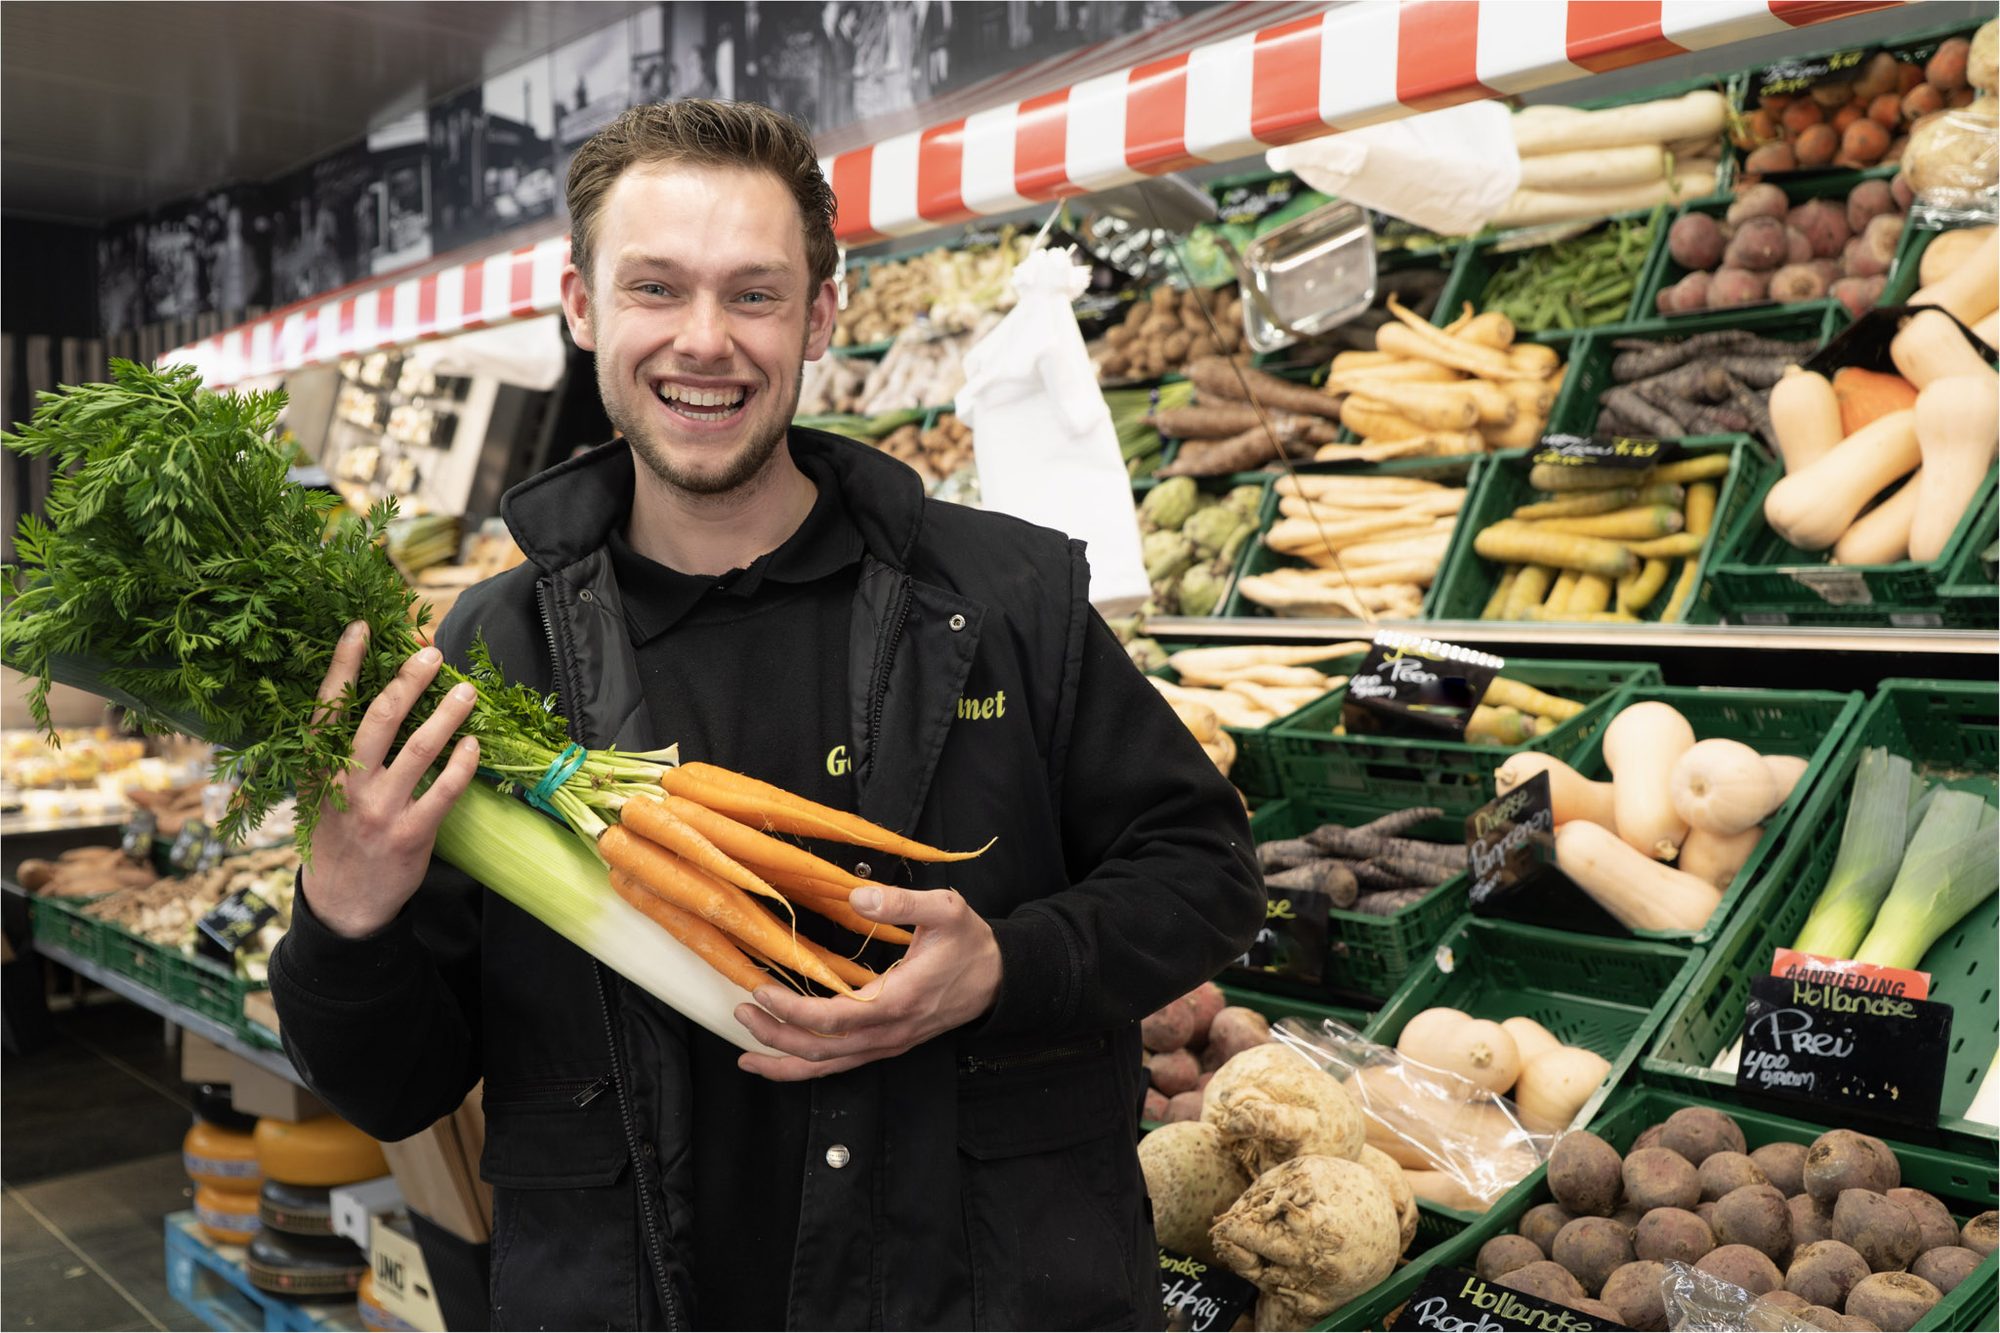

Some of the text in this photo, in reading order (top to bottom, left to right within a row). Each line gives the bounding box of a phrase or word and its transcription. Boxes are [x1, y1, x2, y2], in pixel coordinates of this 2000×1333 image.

[957, 690, 1006, 720] inet
[1785, 964, 1906, 997] AANBIEDING
[1793, 981, 1917, 1019] Hollandse
[1743, 1050, 1790, 1079] 400
[1458, 1277, 1592, 1332] Hollandse
